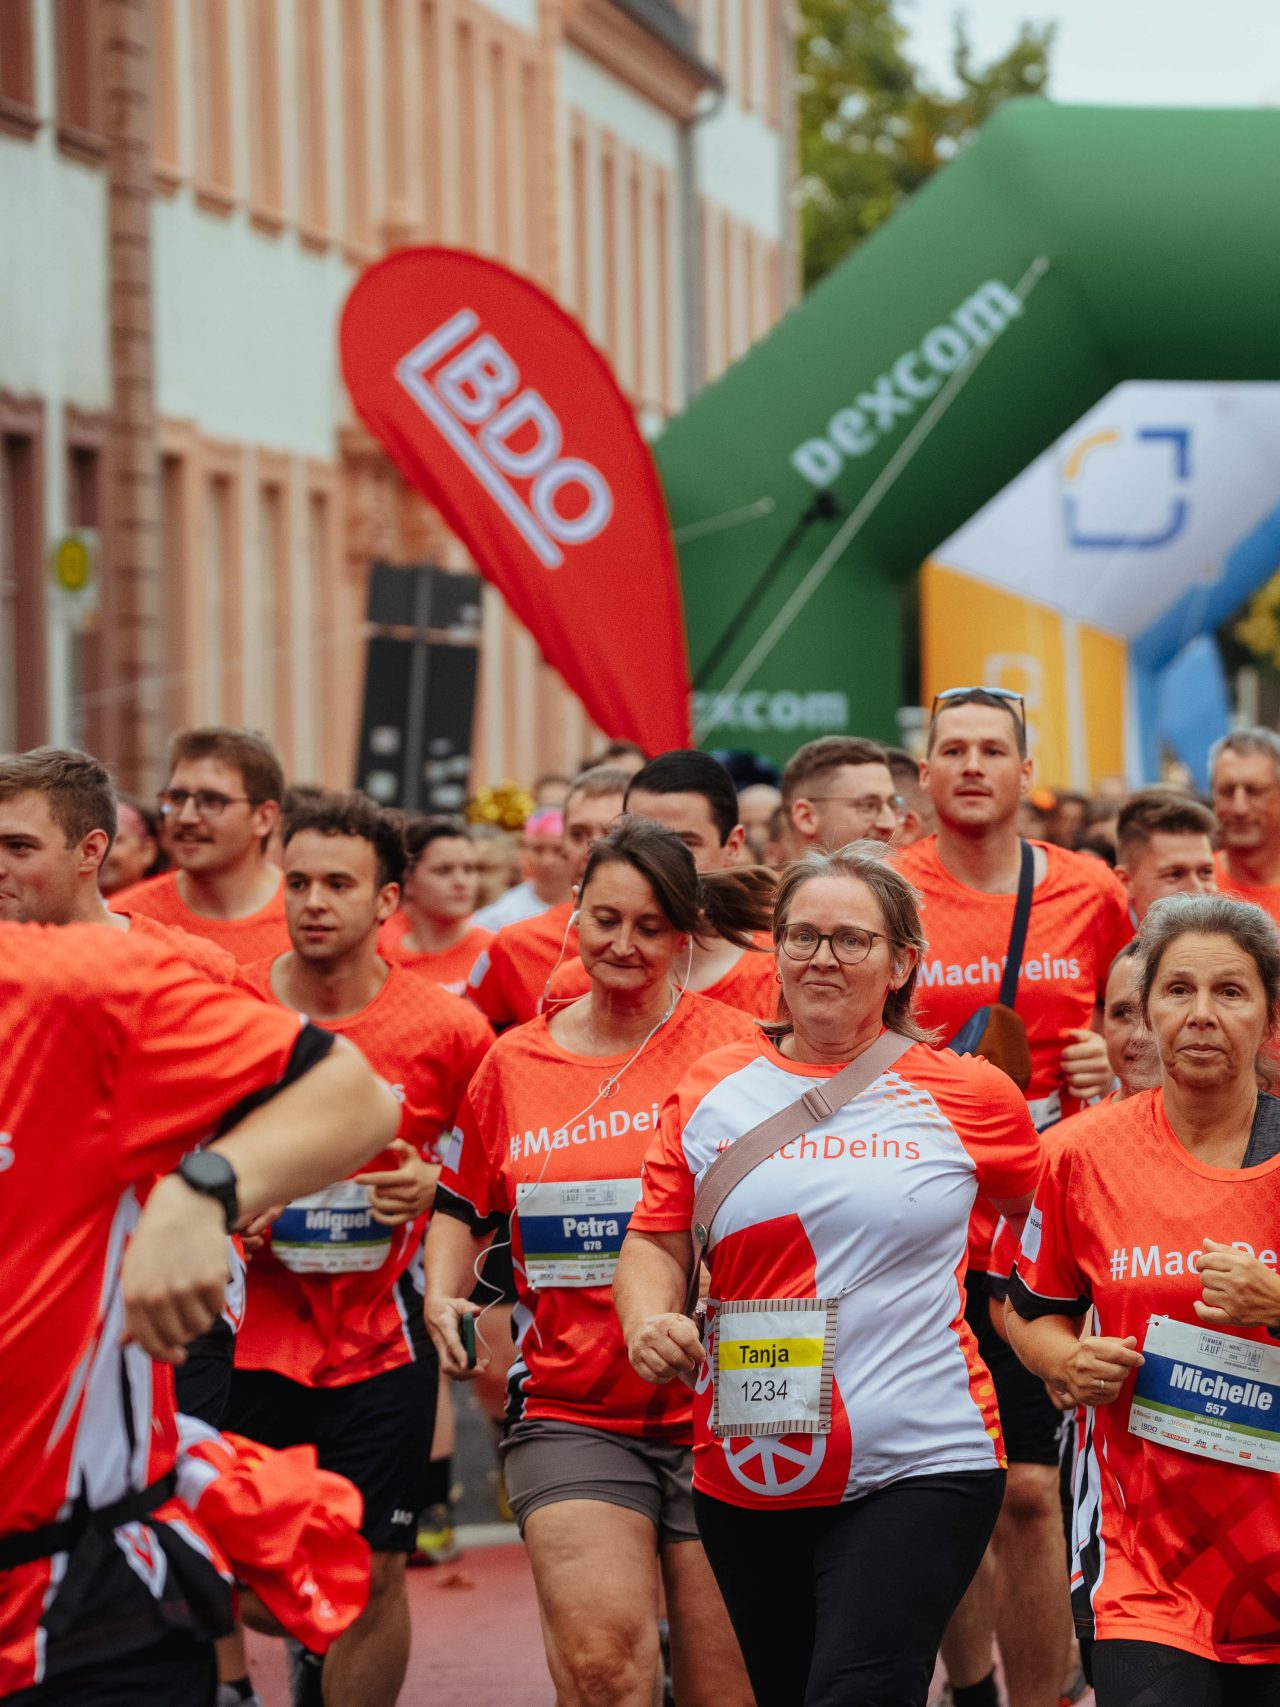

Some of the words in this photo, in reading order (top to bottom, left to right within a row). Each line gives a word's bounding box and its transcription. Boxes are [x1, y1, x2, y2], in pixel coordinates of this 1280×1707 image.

[790, 278, 1025, 488] Dexcom
[436, 334, 613, 544] BDO
[305, 1210, 372, 1232] Miguel
[563, 1217, 619, 1238] Petra
[583, 1240, 602, 1251] 678
[739, 1344, 789, 1368] Tanja
[1200, 1343, 1221, 1355] LAUF
[741, 1379, 788, 1402] 1234
[1169, 1363, 1273, 1411] Michelle
[1205, 1402, 1228, 1417] 557
[1143, 1423, 1158, 1433] BDO
